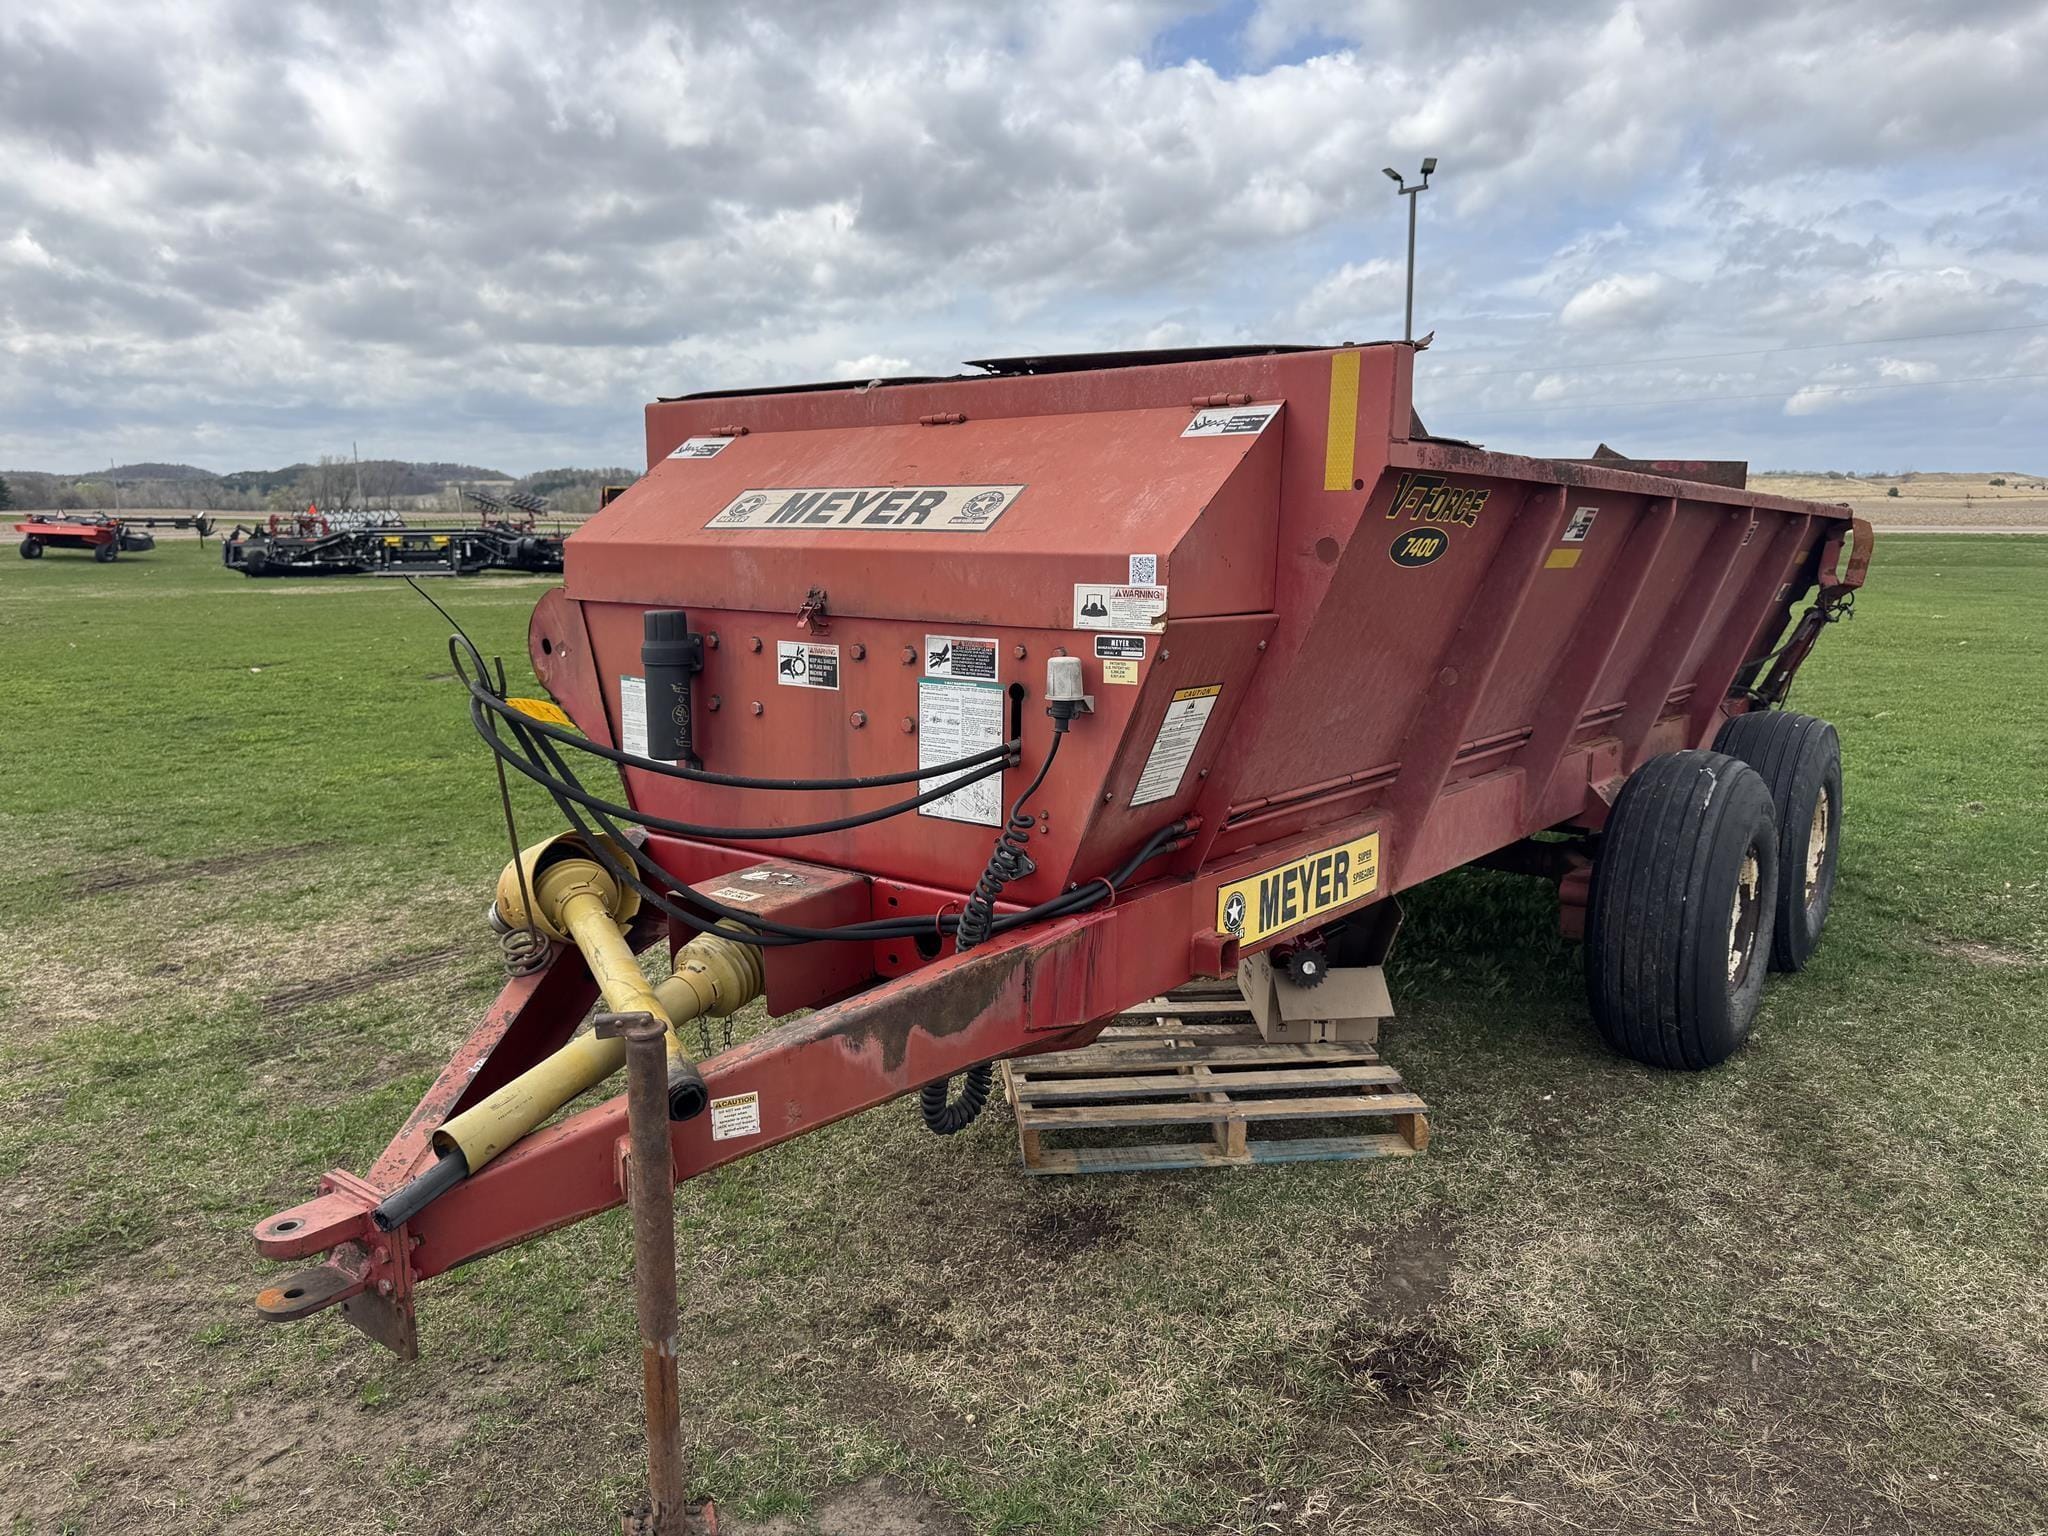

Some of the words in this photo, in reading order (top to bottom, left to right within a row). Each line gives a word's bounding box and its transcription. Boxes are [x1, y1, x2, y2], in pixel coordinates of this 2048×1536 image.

[765, 491, 947, 525] MEYER
[1400, 537, 1440, 557] 7400
[1122, 589, 1160, 599] WARNING
[1184, 687, 1212, 698] CAUTION
[1358, 849, 1372, 863] SUPER
[1353, 866, 1375, 883] SPREADER
[1259, 850, 1350, 933] MEYER
[722, 1096, 754, 1106] CAUTION
